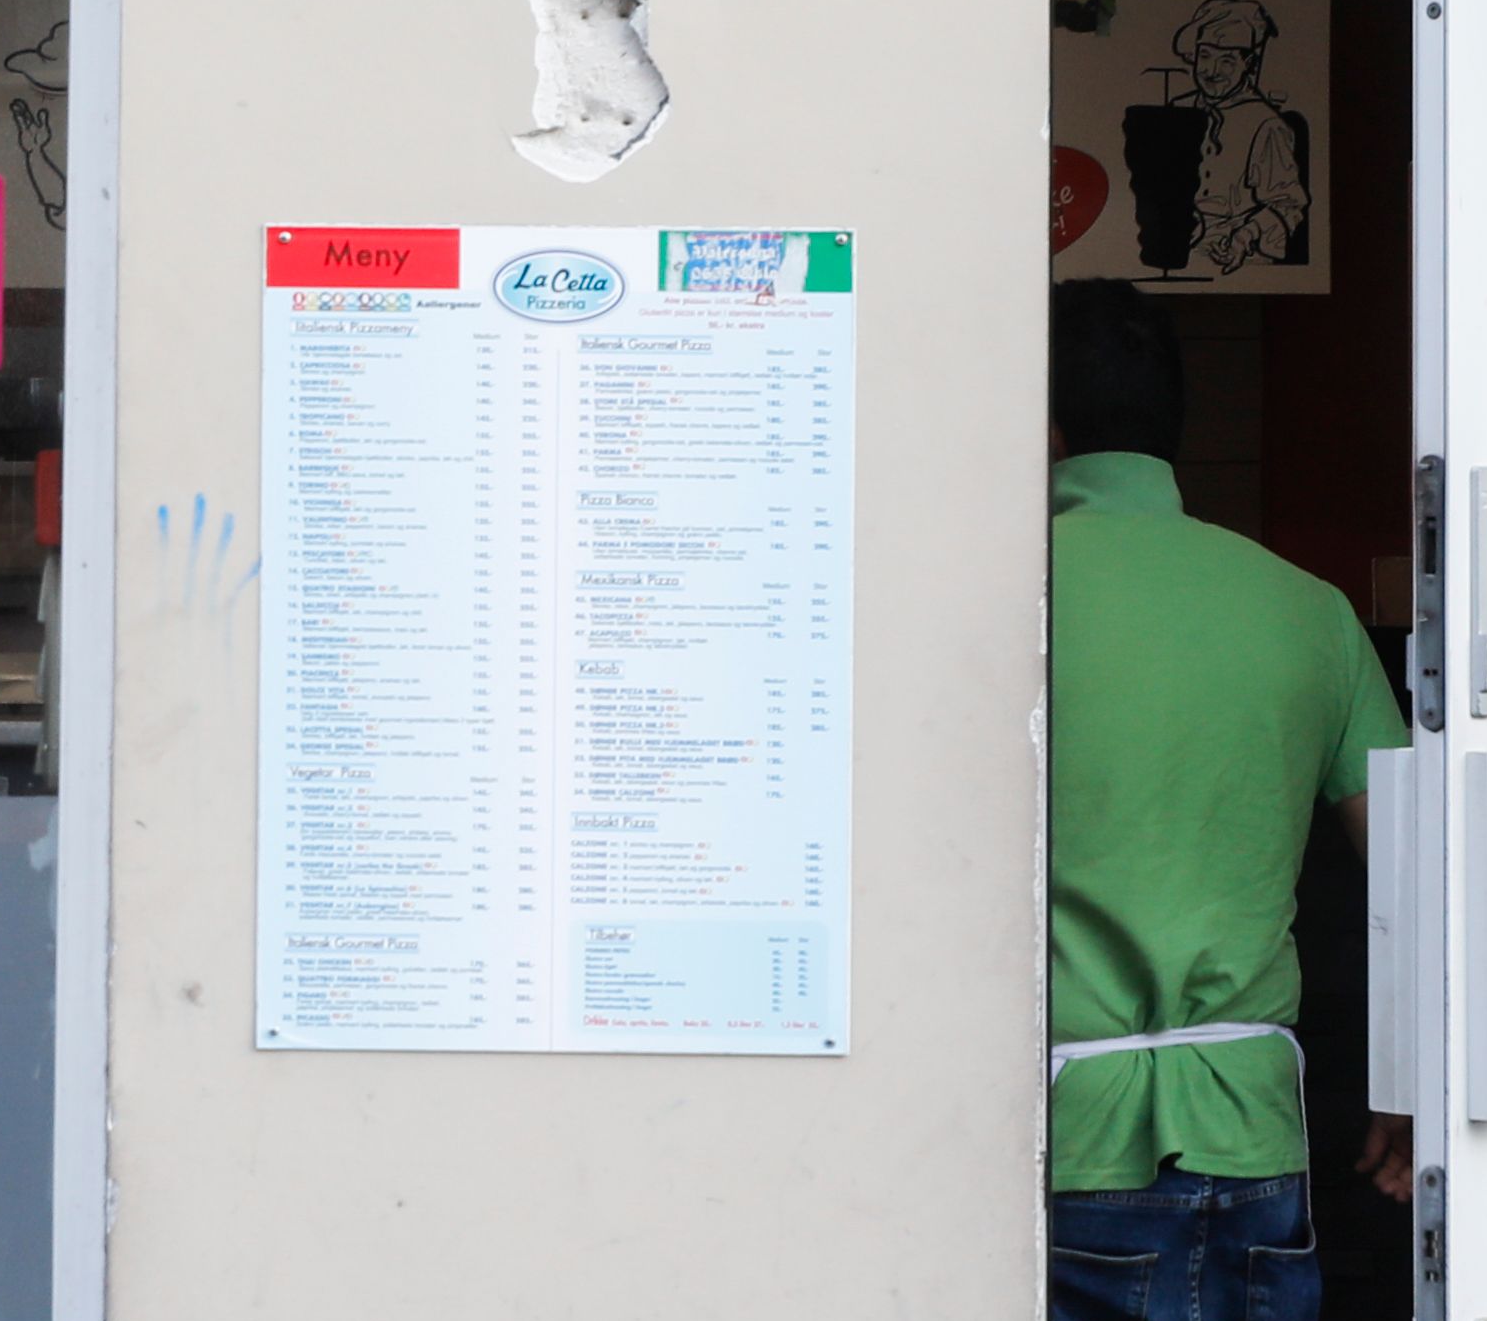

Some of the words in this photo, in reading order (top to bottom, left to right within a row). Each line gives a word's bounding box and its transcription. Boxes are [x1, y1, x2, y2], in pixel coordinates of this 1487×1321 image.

[323, 240, 412, 277] Meny
[512, 262, 547, 291] La
[551, 265, 611, 294] Cetta
[526, 294, 587, 313] Pizzeria
[628, 339, 678, 350] Gourmet
[681, 340, 711, 351] Pizza
[580, 494, 612, 506] Pizza
[647, 574, 679, 587] Pizza
[579, 662, 619, 675] Kebab
[341, 767, 371, 779] Pizza
[622, 816, 656, 829] Pizza
